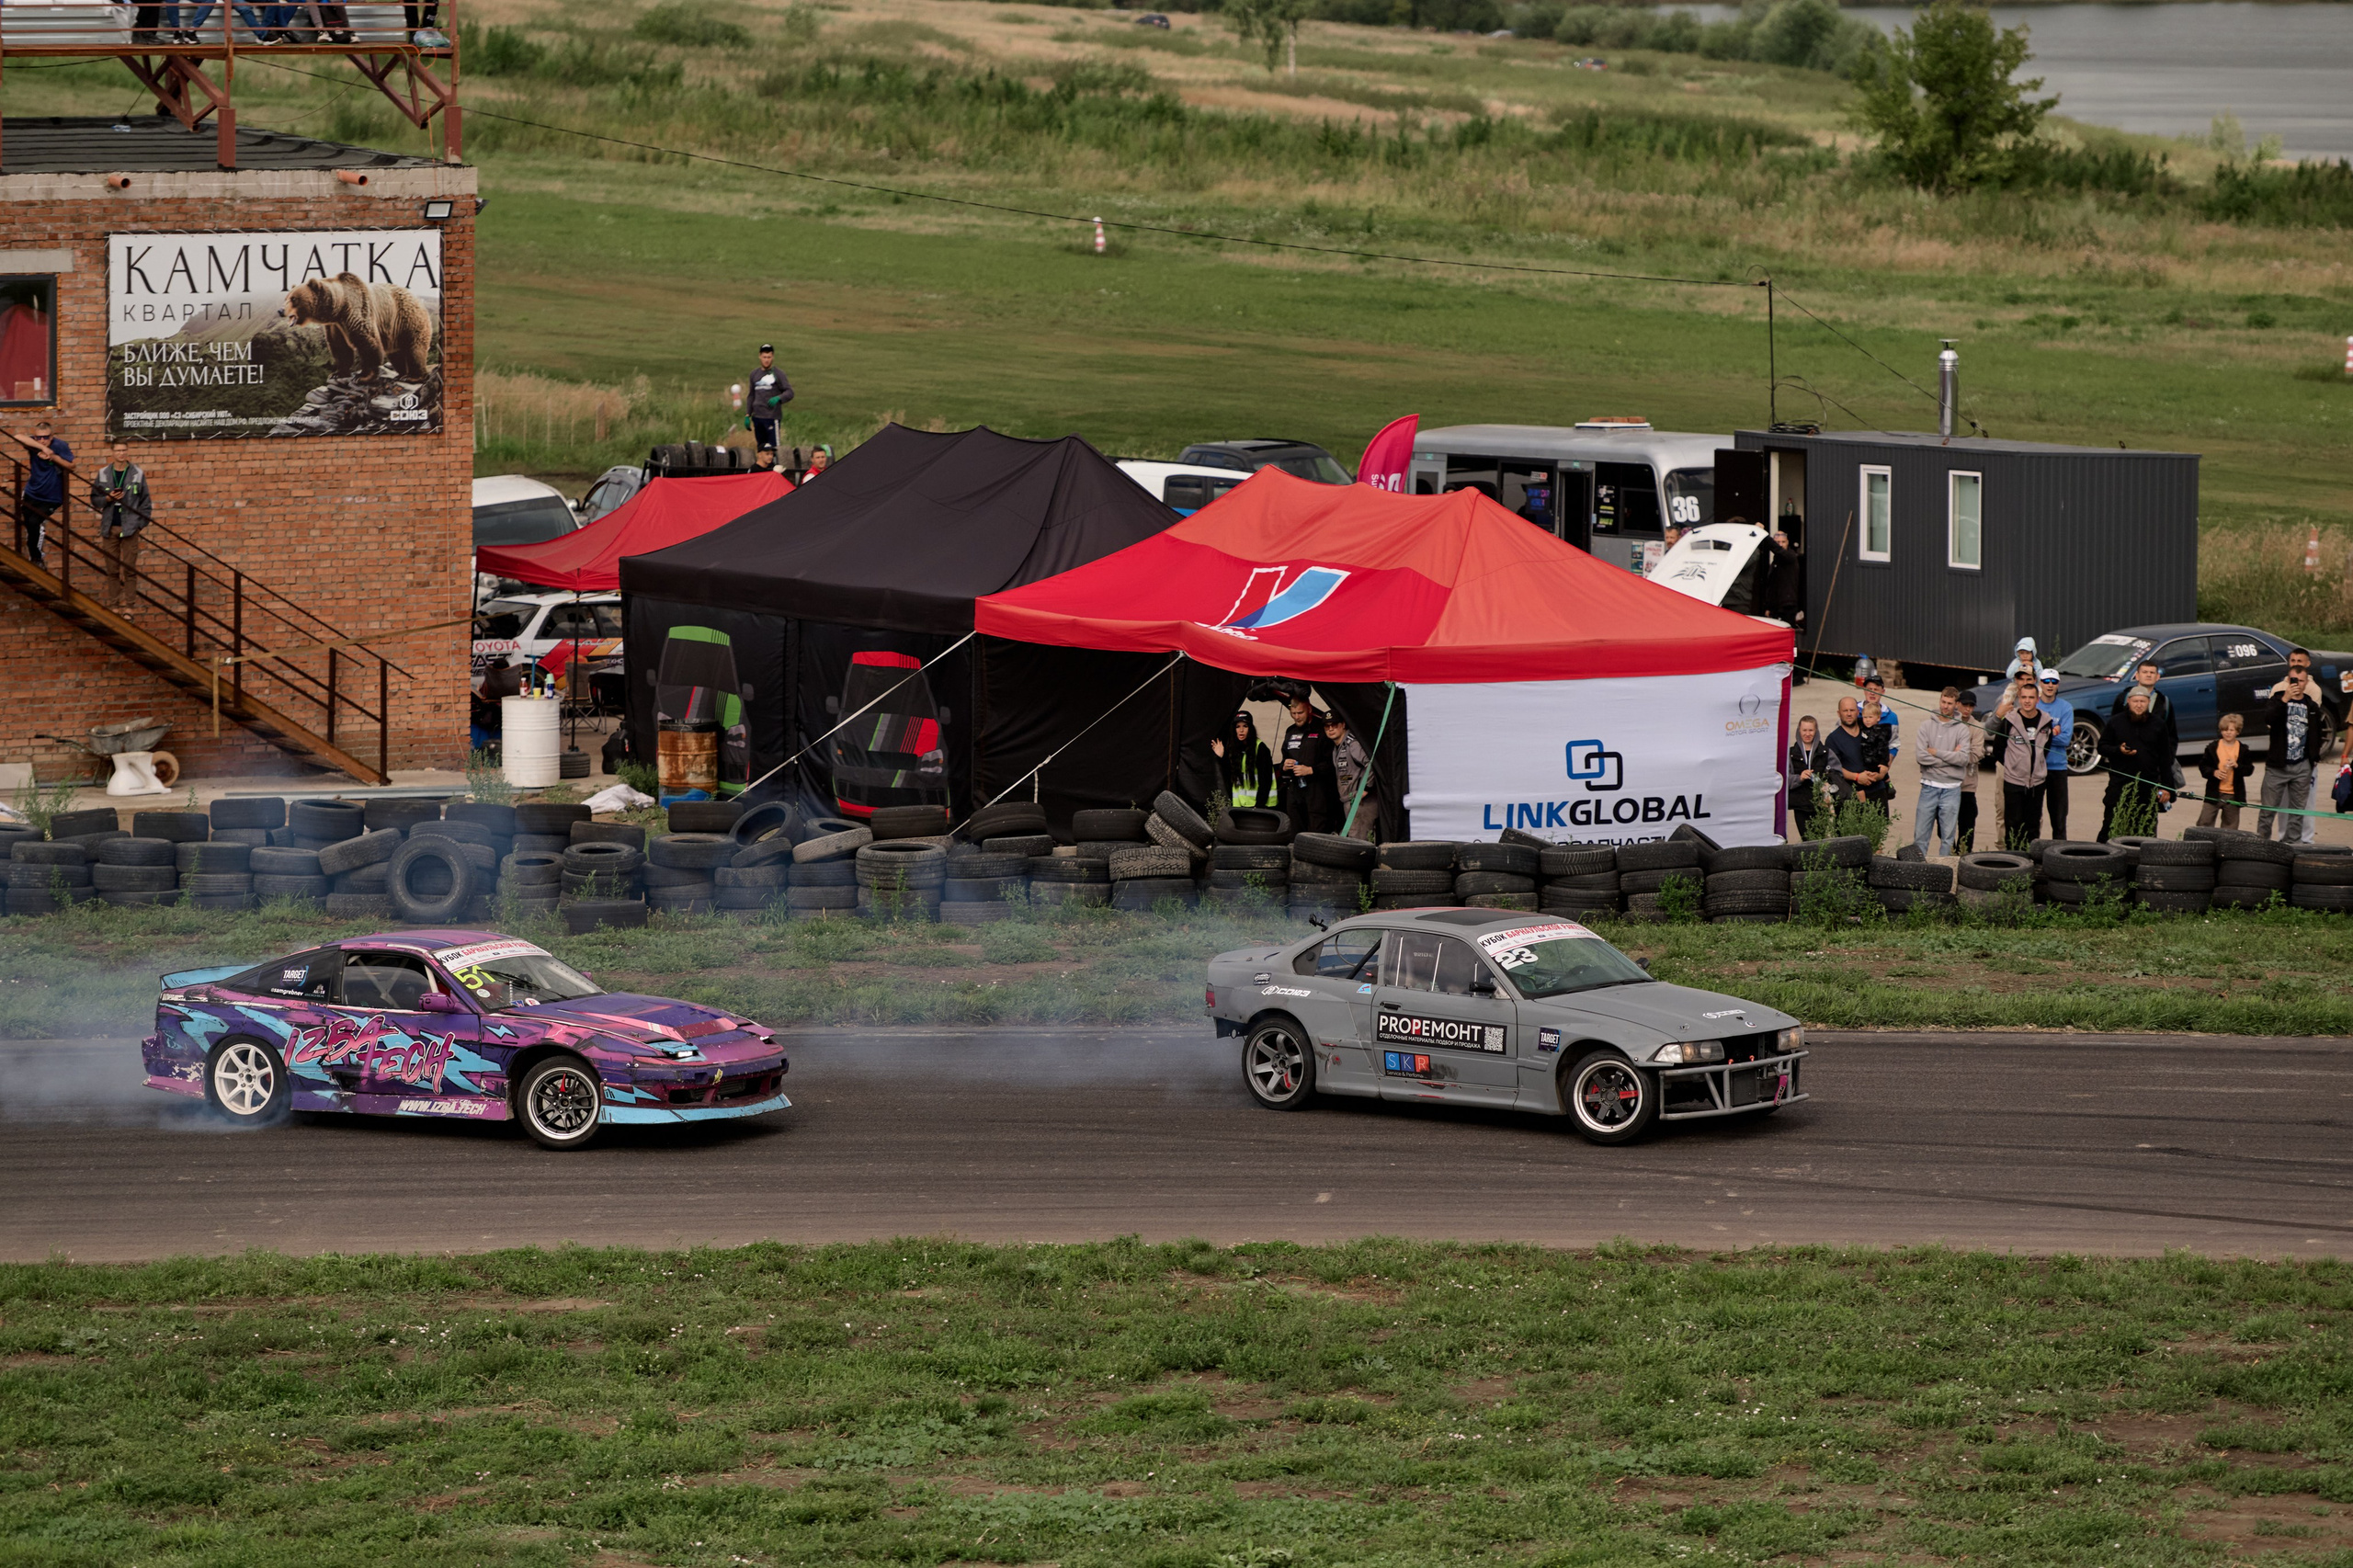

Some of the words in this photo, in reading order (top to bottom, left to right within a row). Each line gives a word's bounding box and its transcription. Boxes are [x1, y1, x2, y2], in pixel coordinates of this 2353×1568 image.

[124, 241, 439, 294] КАМЧАТКА
[123, 302, 252, 322] КВАРТАЛ
[124, 342, 203, 364] БЛИЖЕ,
[210, 341, 252, 361] ЧЕМ
[124, 367, 153, 387] ВЫ
[159, 364, 264, 387] ДУМАЕТЕ!
[390, 409, 428, 421] СОЮЗ
[1672, 495, 1700, 522] 36
[475, 641, 521, 653] OYOTA
[2235, 643, 2258, 658] 096
[1725, 718, 1770, 732] OMEGA
[1483, 794, 1711, 830] LINKGLOBAL
[1480, 933, 1507, 948] КУБОК
[1506, 923, 1562, 938] БАРНАУЛЬСКОЙ
[438, 950, 463, 964] КУБОК
[461, 941, 513, 956] БАРНАУЛЬСКОЙ
[1495, 947, 1539, 971] 23
[283, 970, 307, 979] TARGET
[453, 964, 496, 990] 51
[1277, 988, 1312, 997] СОЮЗ
[284, 1015, 399, 1068] IZBA
[1540, 1032, 1560, 1044] TARGET
[357, 1031, 456, 1095] TECH
[1388, 1054, 1427, 1071] SKR
[397, 1099, 487, 1116] WWW.IZBA.TECH
